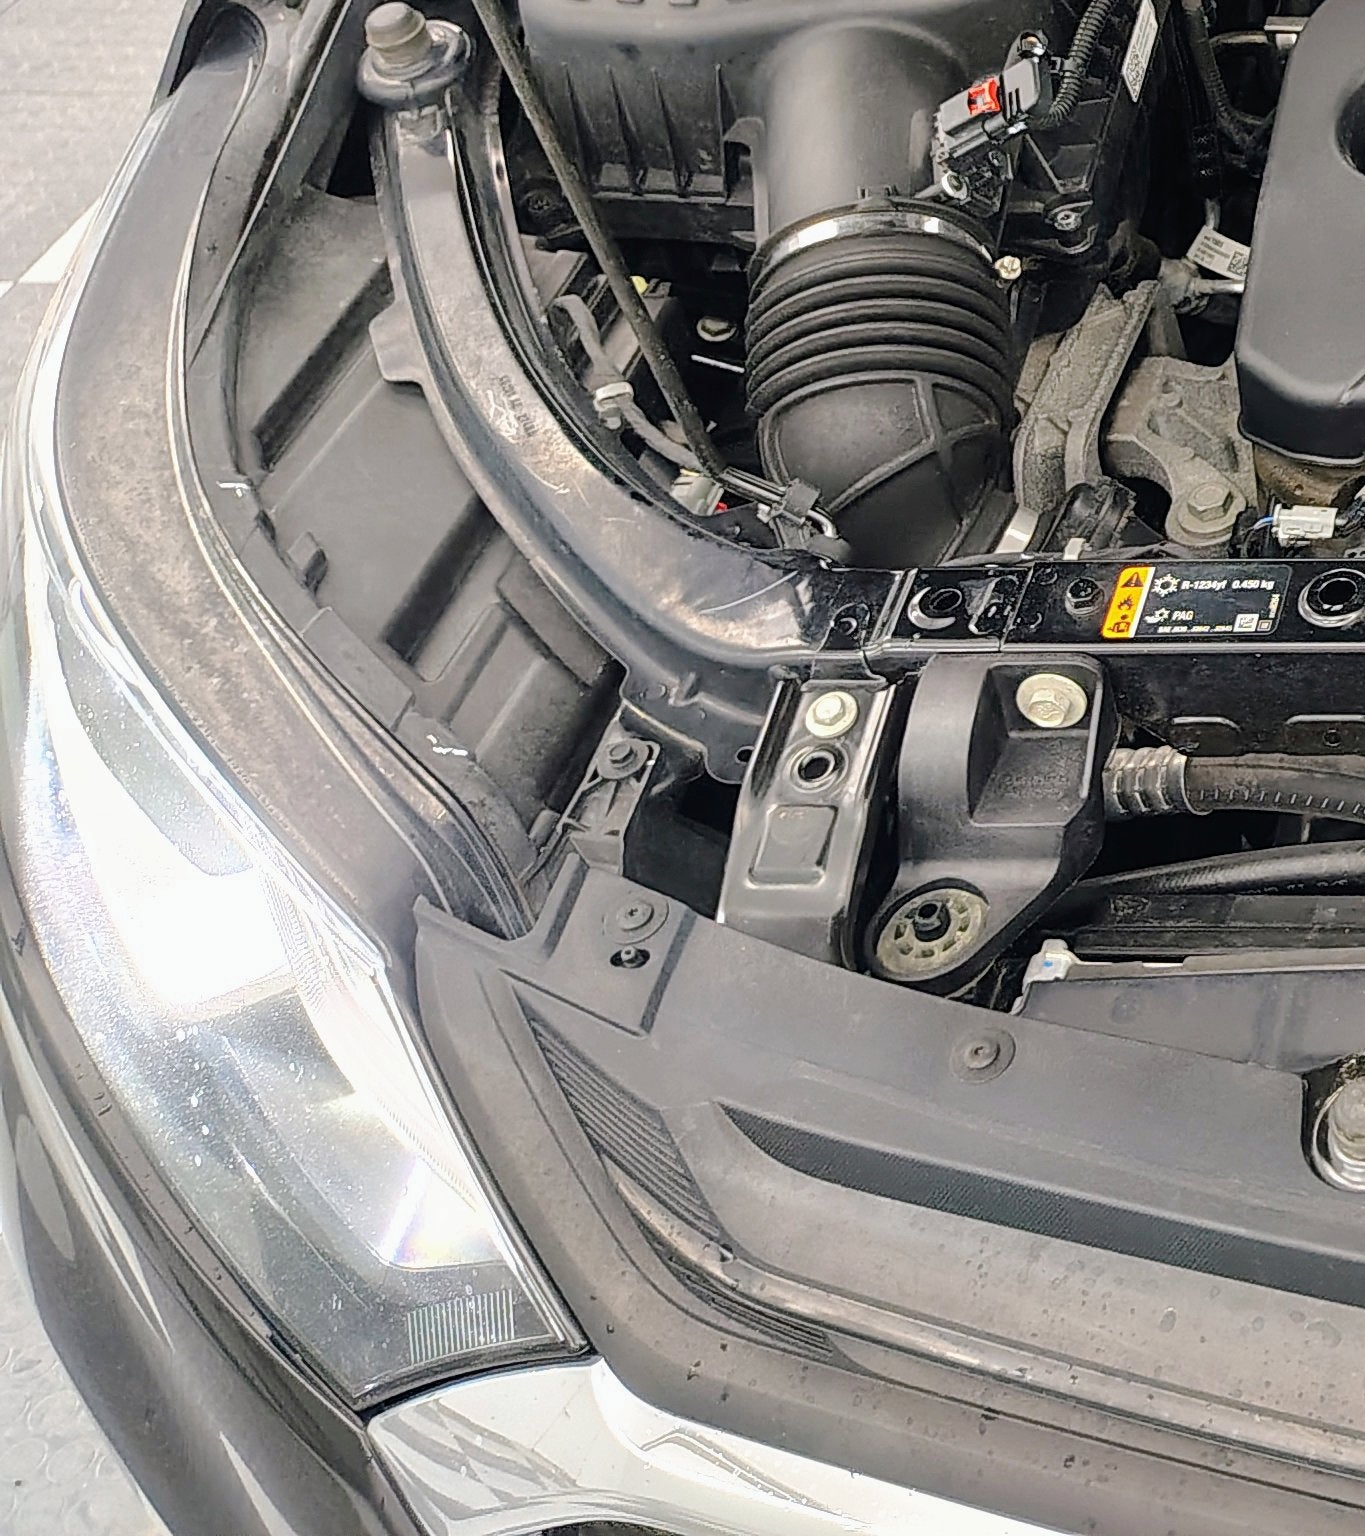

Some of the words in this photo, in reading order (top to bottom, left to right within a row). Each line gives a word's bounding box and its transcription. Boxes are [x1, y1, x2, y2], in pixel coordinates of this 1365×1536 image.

[1181, 579, 1227, 591] R-1234yf
[1231, 579, 1260, 590] 0.450
[1260, 579, 1275, 591] kg
[1172, 610, 1194, 621] PAG
